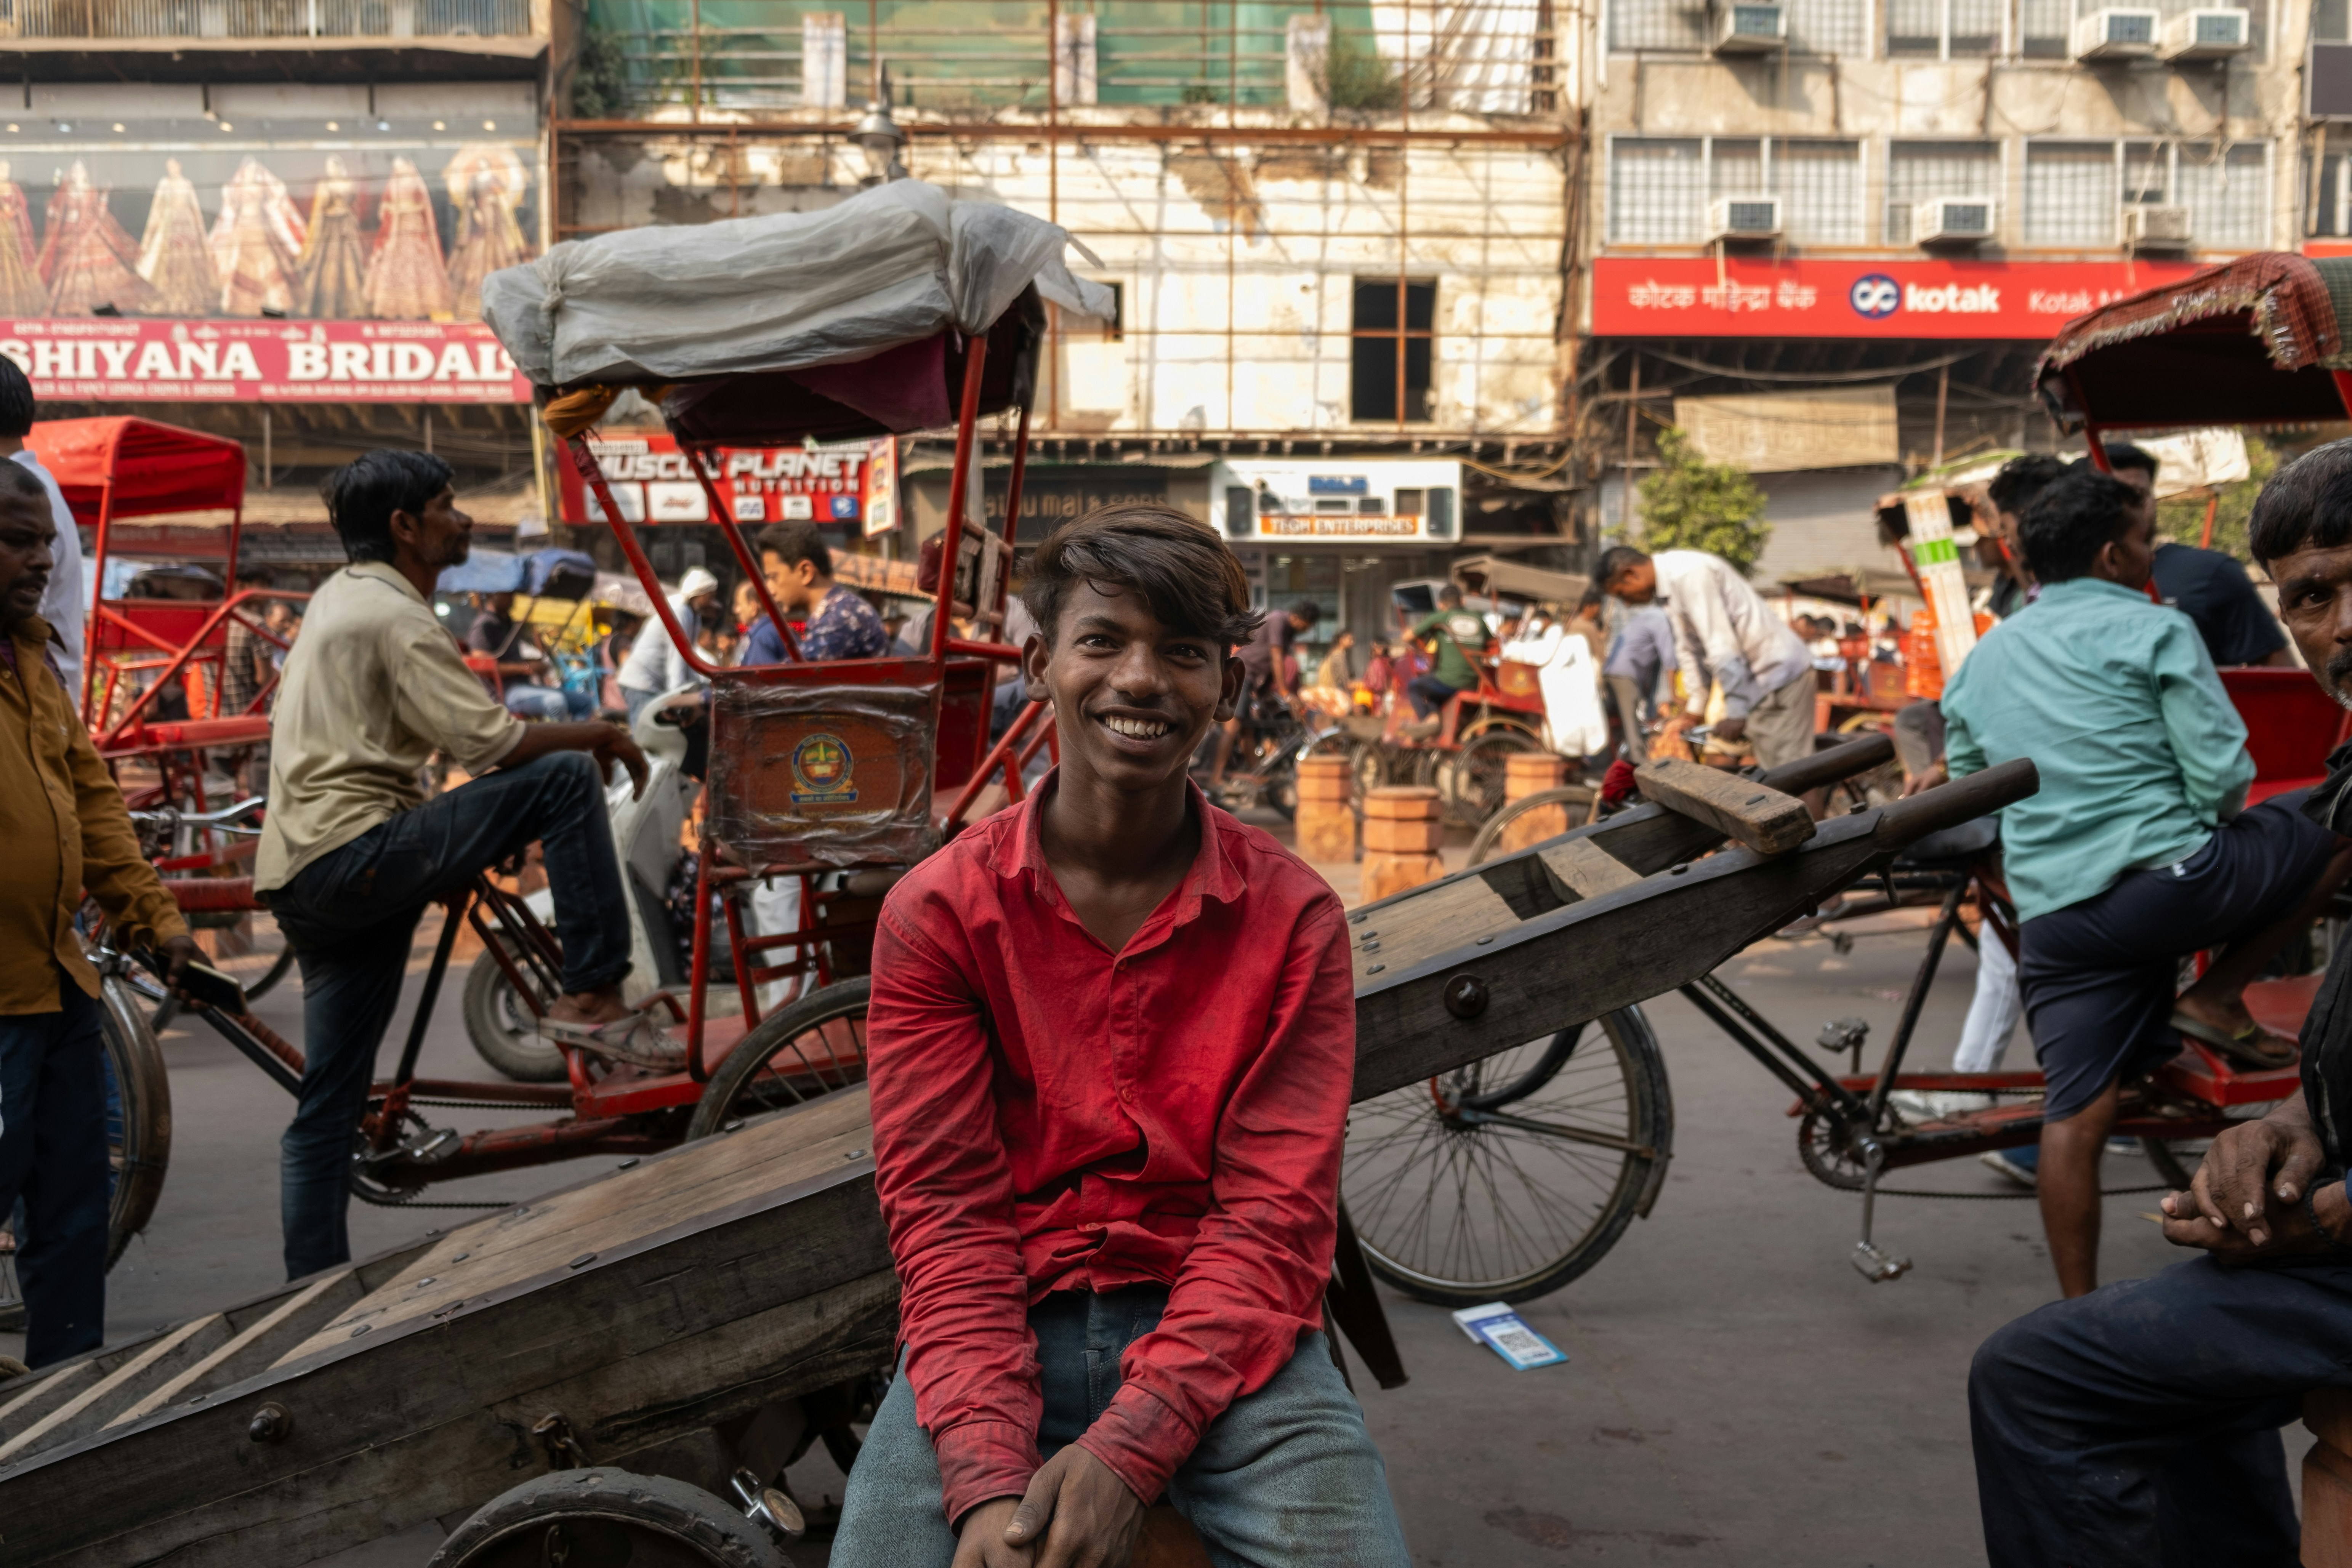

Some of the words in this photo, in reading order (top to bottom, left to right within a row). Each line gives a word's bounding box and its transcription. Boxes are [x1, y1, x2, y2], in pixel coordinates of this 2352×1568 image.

[1906, 283, 1999, 312] kotak
[2030, 288, 2092, 312] Kotak
[729, 453, 867, 478] PLANET
[733, 479, 859, 493] NUTRITION
[1316, 518, 1414, 532] ENTERPRISES
